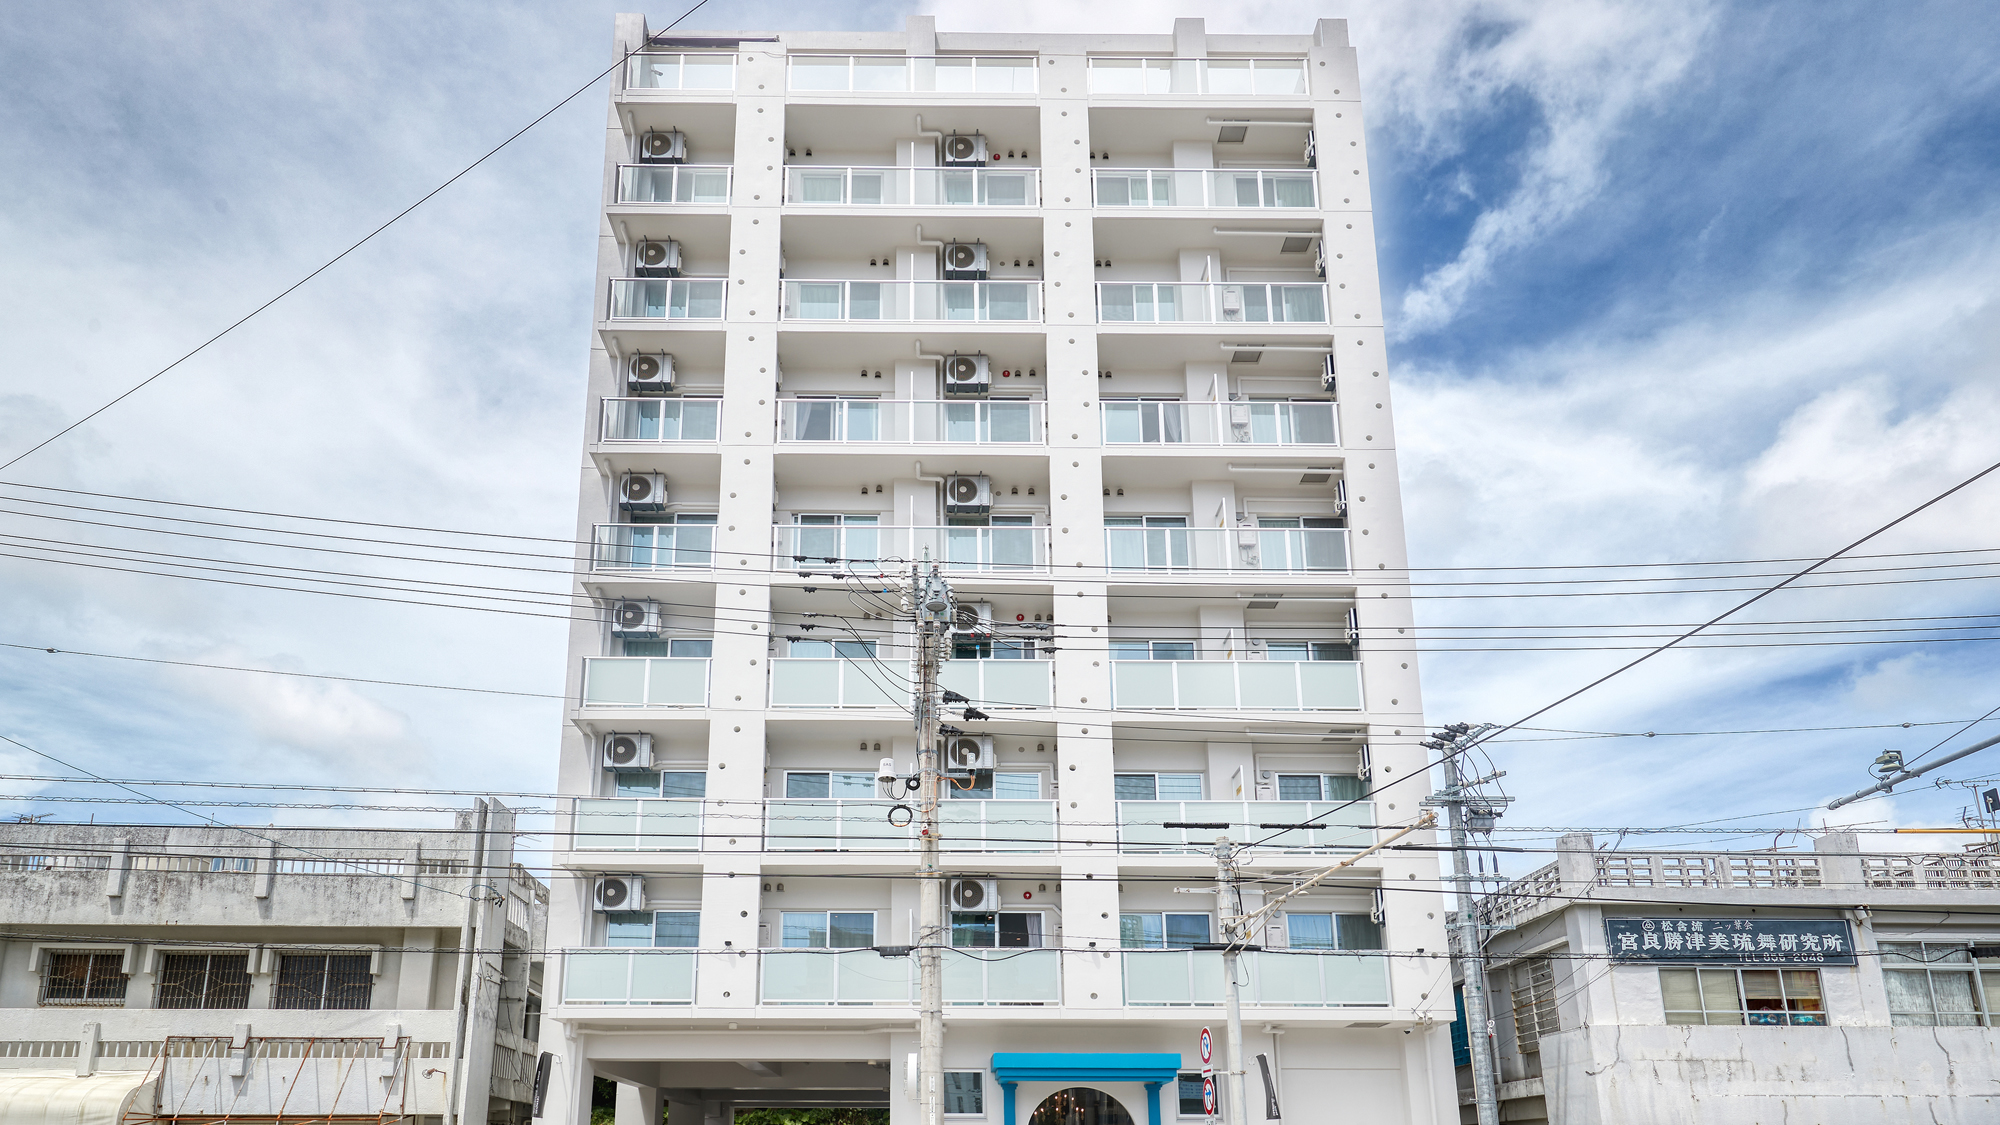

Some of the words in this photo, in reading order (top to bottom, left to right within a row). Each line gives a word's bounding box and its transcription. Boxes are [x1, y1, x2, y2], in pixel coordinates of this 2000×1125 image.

[1617, 932, 1844, 951] 宮良勝津美琉舞研究所
